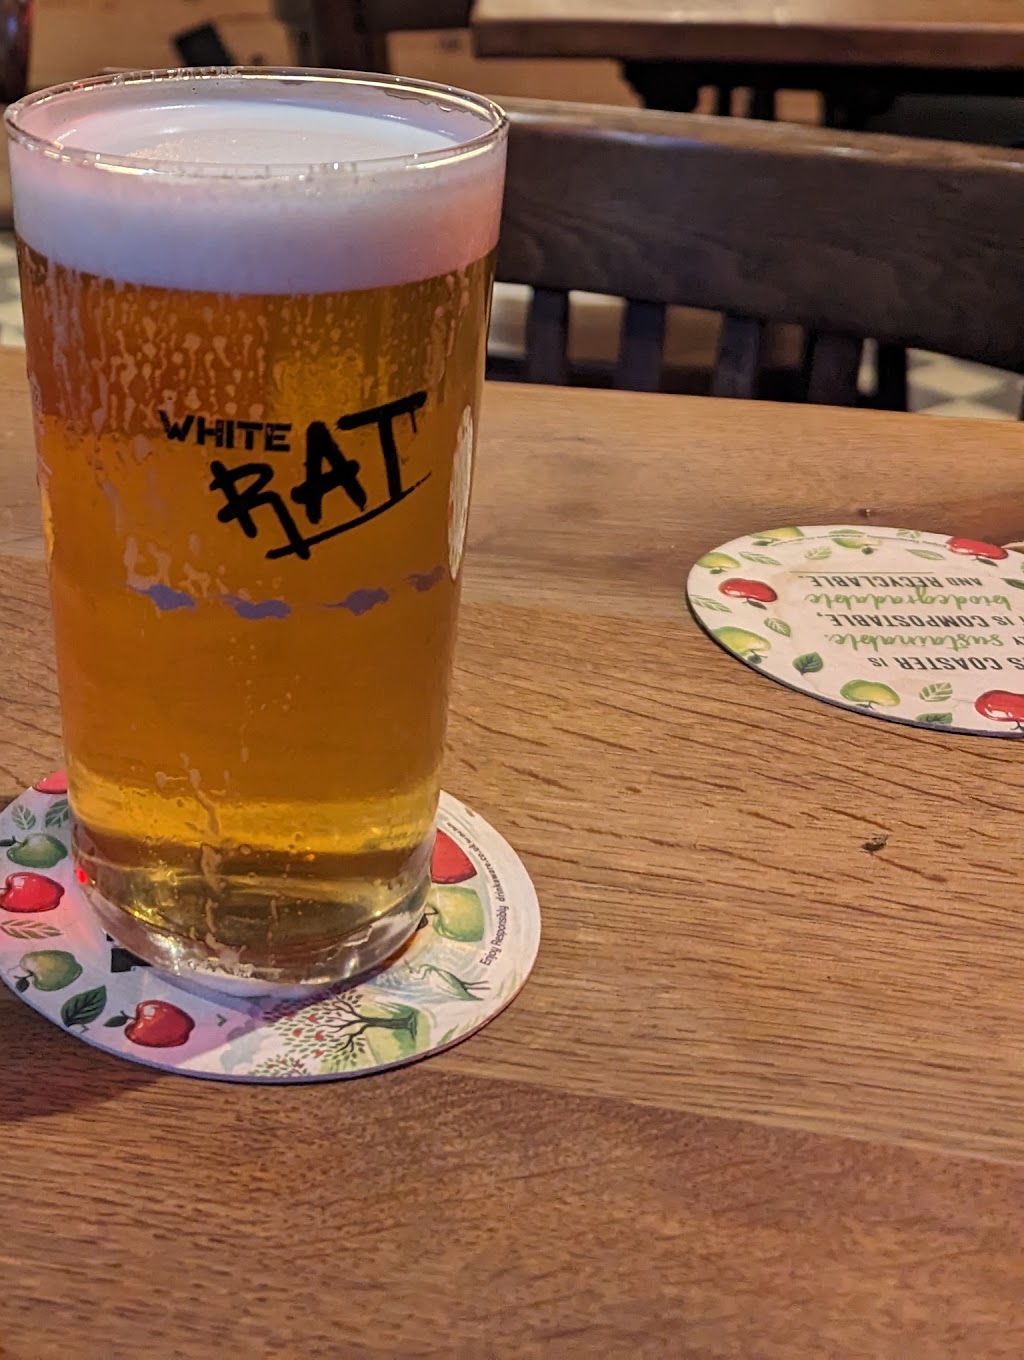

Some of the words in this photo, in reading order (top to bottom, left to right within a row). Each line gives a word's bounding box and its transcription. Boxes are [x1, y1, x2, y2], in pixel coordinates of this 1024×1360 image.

[159, 410, 292, 453] WHITE
[210, 391, 429, 560] RAT
[797, 575, 944, 588] RECYCLABLE.
[945, 576, 983, 587] AND
[804, 584, 1012, 611] biodegradable
[816, 612, 990, 628] COMPOSTABLE,
[991, 615, 1015, 626] IS
[824, 633, 1004, 652] sustainable.
[867, 657, 888, 667] IS
[892, 656, 1003, 670] COASTER
[469, 843, 506, 902] drinkaware.co.uk
[491, 904, 509, 948] Responsibly
[480, 946, 502, 966] Enjoy
